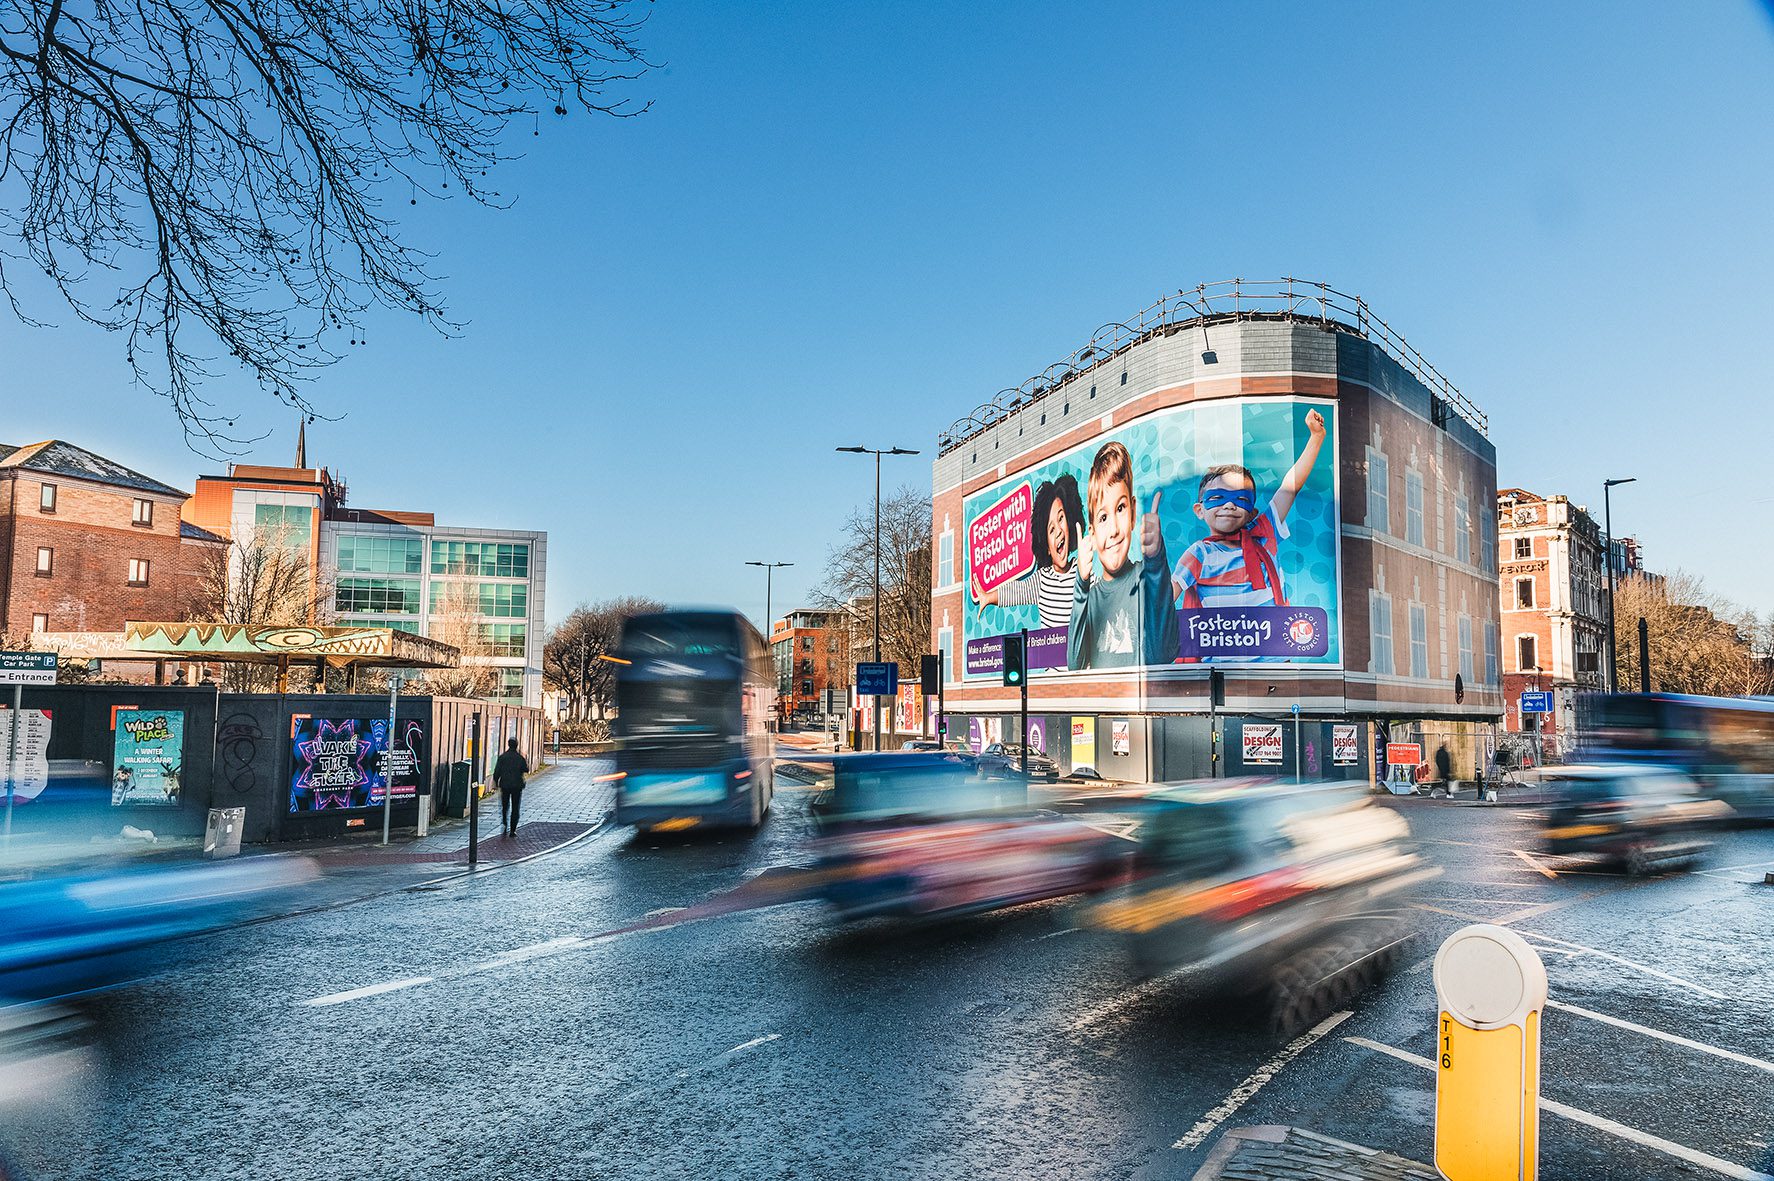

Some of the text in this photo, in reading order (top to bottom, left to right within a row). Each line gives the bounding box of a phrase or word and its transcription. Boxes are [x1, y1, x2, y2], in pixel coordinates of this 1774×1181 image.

[973, 492, 1026, 545] Foster with
[974, 519, 1028, 567] Bristol City
[983, 545, 1019, 584] Council
[1188, 613, 1271, 640] Fostering
[1284, 612, 1318, 627] BRISTOL
[968, 645, 979, 655] Make
[982, 642, 1002, 653] difference
[1031, 634, 1046, 647] Bristol
[1047, 633, 1067, 645] children
[1200, 631, 1260, 647] Bristol
[1282, 632, 1320, 651] CITY COUNCIL
[9, 673, 54, 682] Entrance
[125, 720, 154, 732] WILD
[135, 728, 168, 742] PLACE
[1244, 736, 1281, 747] DESIGN
[1334, 738, 1357, 748] DESIGN
[312, 736, 358, 755] WAKE
[319, 755, 349, 772] THE
[310, 770, 355, 787] TIGER
